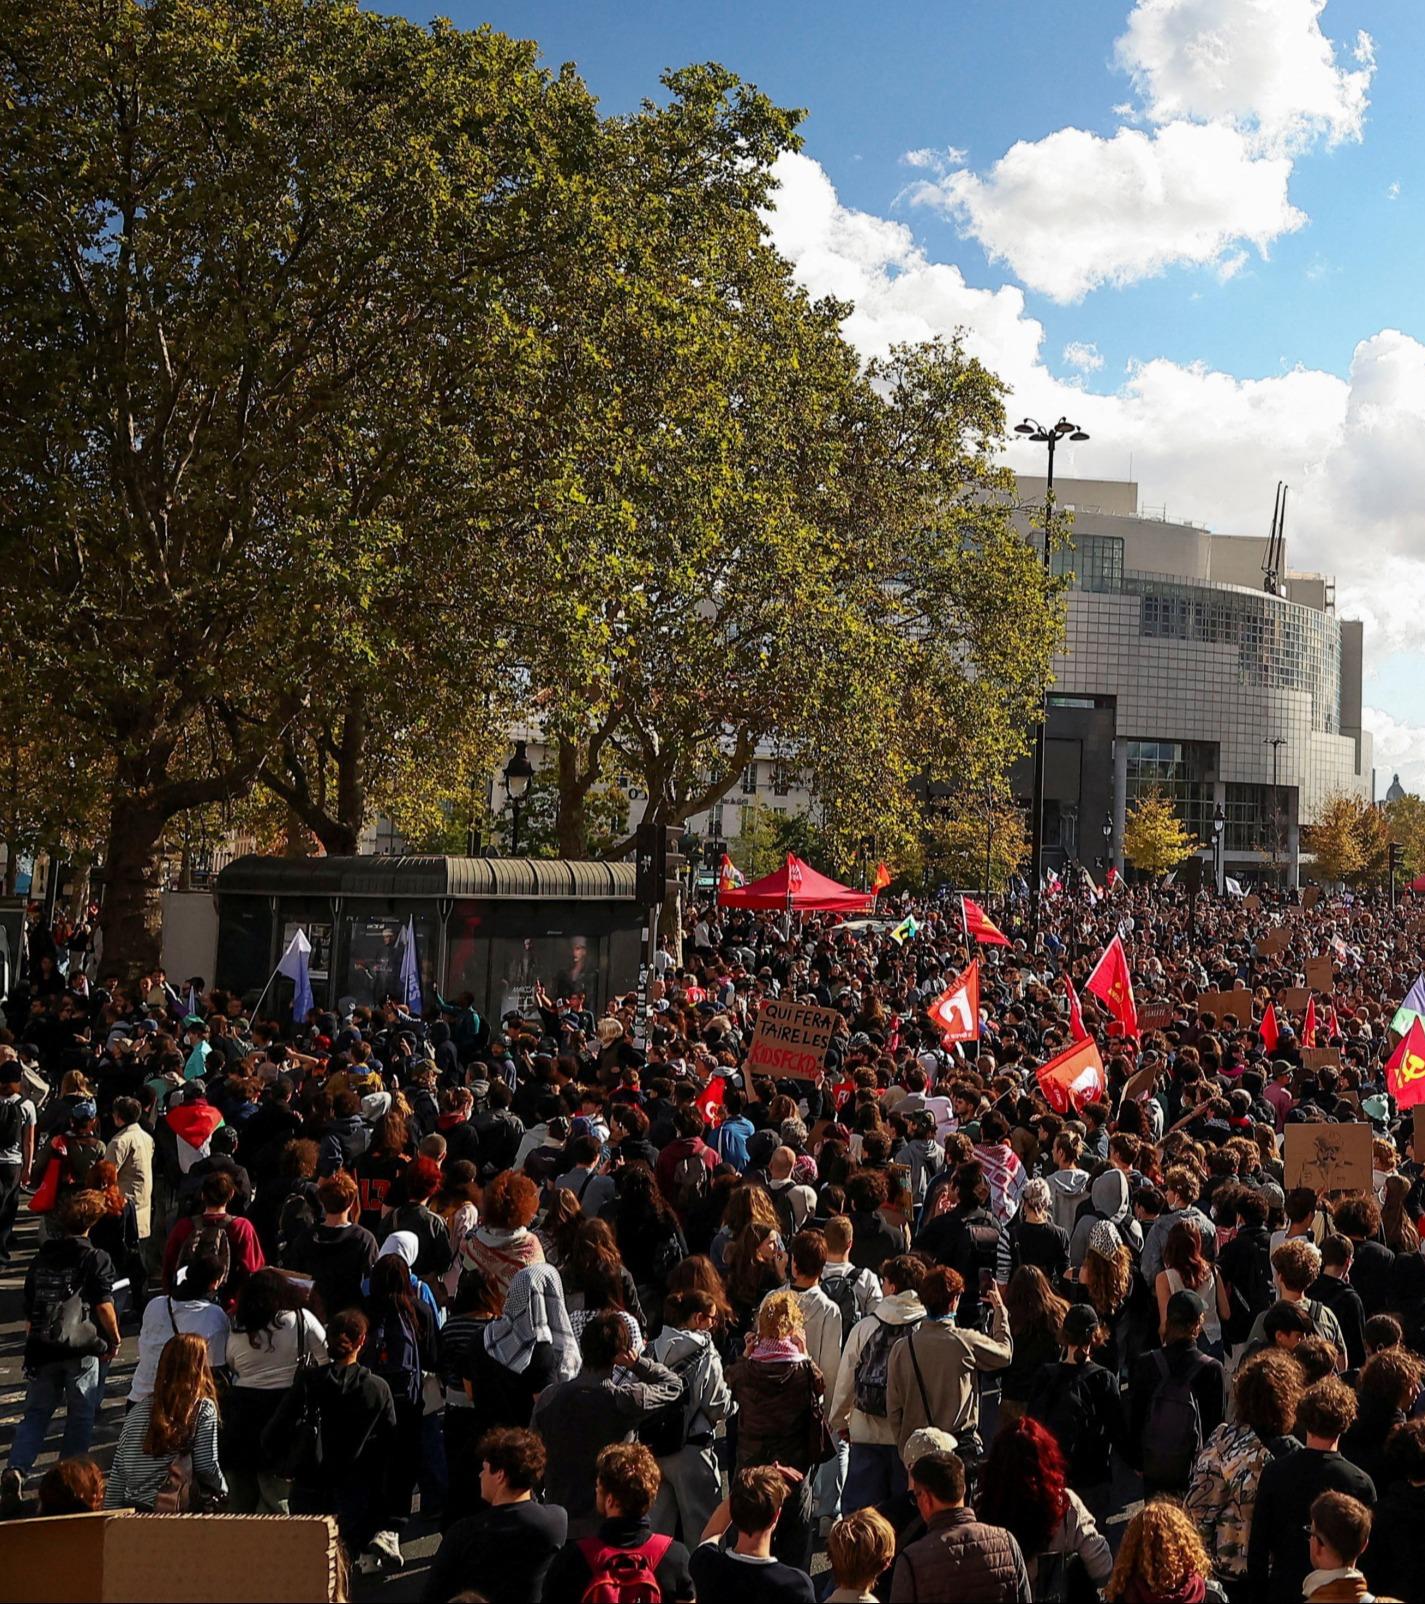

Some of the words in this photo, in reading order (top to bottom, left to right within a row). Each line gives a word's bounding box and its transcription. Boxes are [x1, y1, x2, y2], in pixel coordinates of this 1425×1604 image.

[766, 1004, 792, 1020] QUI
[793, 1010, 832, 1030] FERA
[760, 1020, 800, 1043] TAIRE
[803, 1031, 829, 1048] LES
